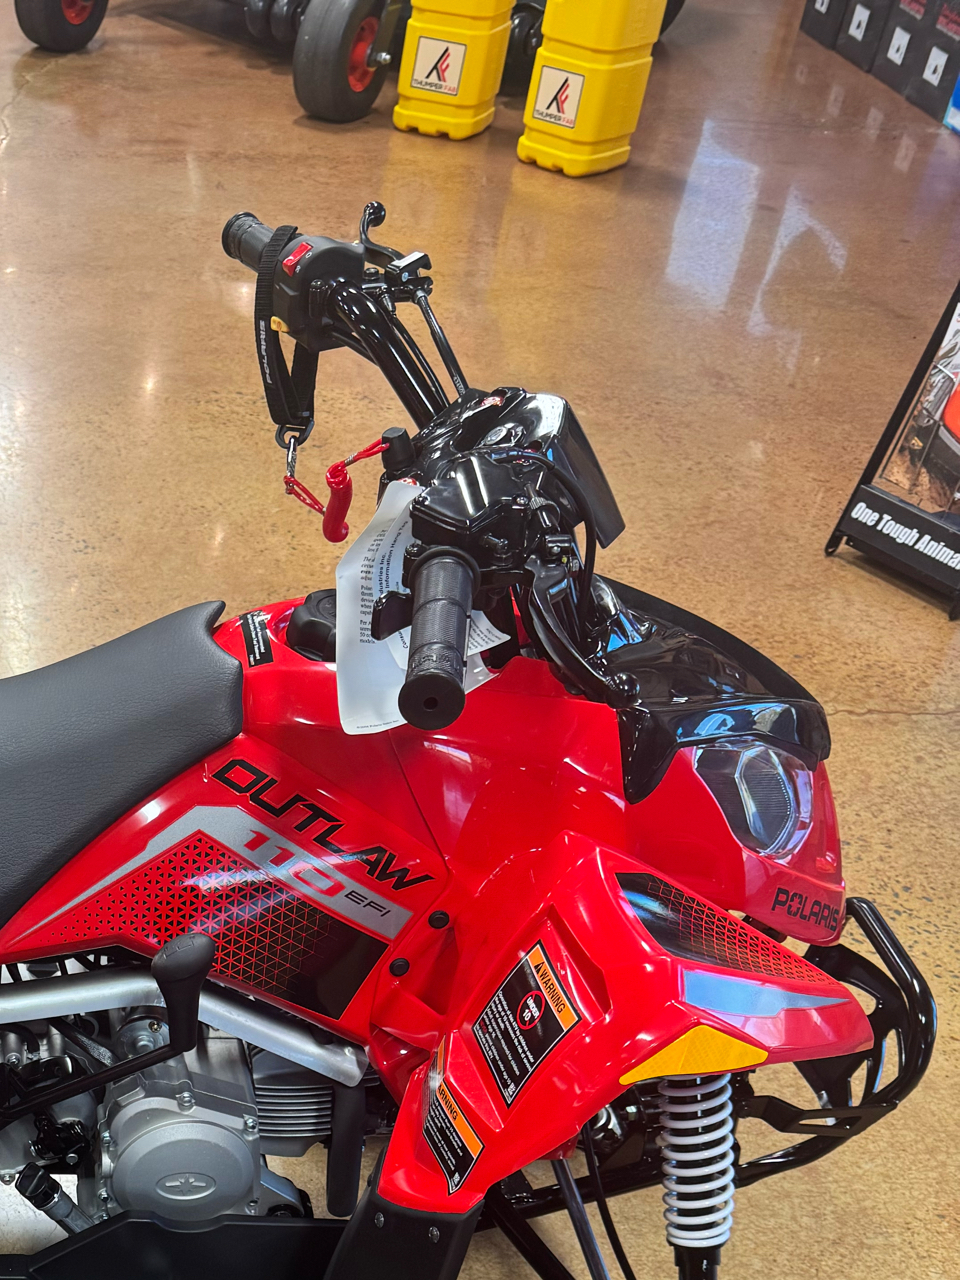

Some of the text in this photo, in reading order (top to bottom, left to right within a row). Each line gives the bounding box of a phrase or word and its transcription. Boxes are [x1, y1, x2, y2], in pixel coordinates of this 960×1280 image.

[413, 79, 457, 94] THUMPER FAB
[534, 109, 574, 126] THUMPER FAB
[259, 320, 273, 384] POLARIS
[851, 501, 960, 572] One Tough Anima
[384, 549, 394, 589] Information
[210, 758, 436, 891] OUTLAW
[243, 829, 392, 917] 110 EFI
[771, 887, 840, 931] POLARIS
[527, 995, 540, 1020] UNDER
[540, 968, 565, 1014] WARNING
[522, 1010, 532, 1022] 10
[438, 1084, 458, 1121] ARNING
